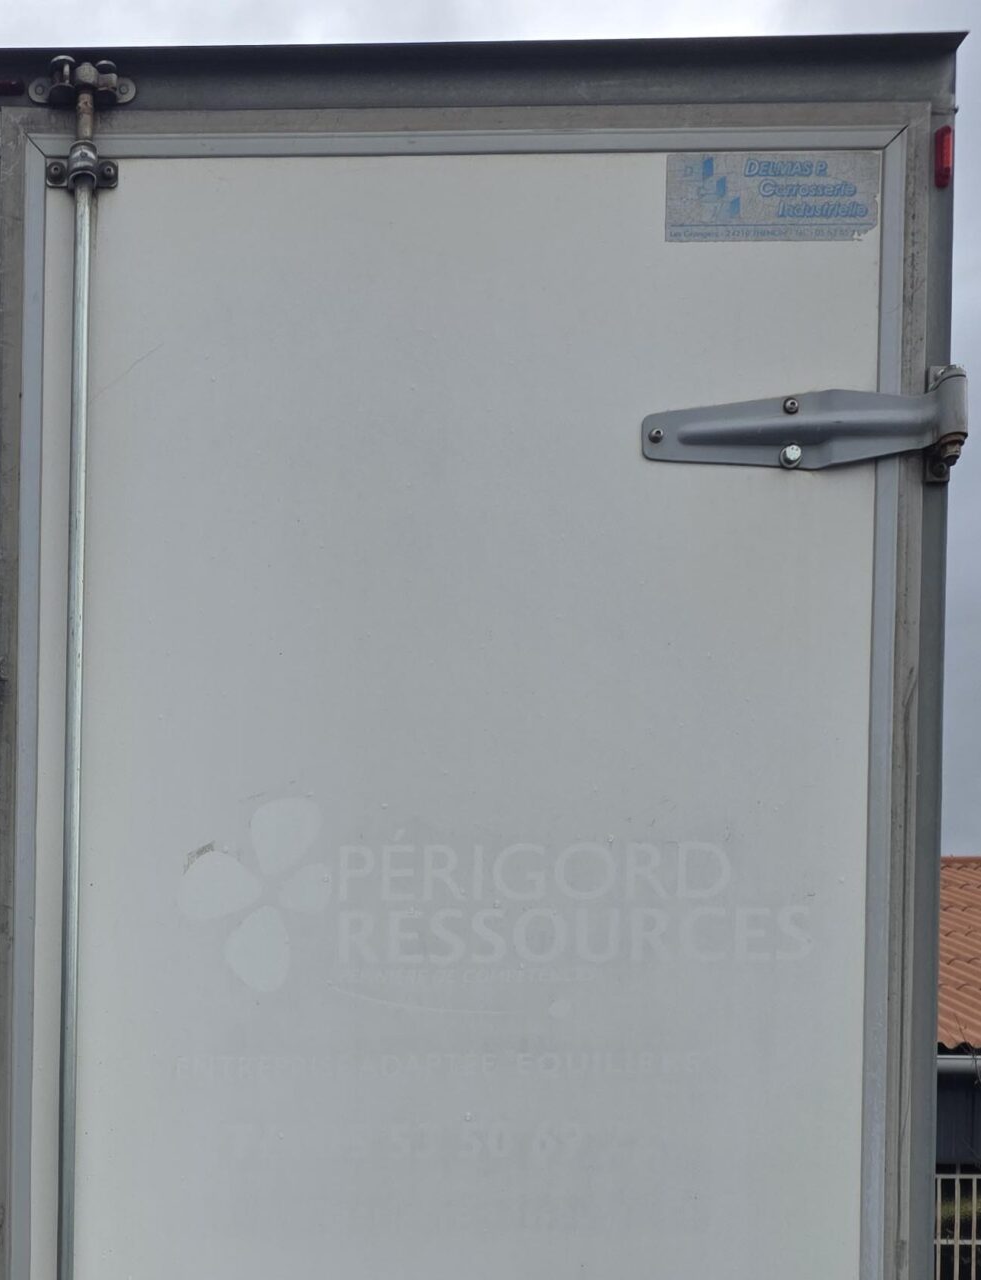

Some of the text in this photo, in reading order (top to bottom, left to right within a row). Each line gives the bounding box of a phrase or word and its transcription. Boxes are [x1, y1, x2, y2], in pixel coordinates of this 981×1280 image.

[744, 159, 813, 177] DELMAS
[758, 179, 857, 197] Carrosserie
[778, 202, 869, 219] Industrielle
[337, 827, 732, 901] PÉRIGORD
[337, 903, 814, 965] RESSOURCES
